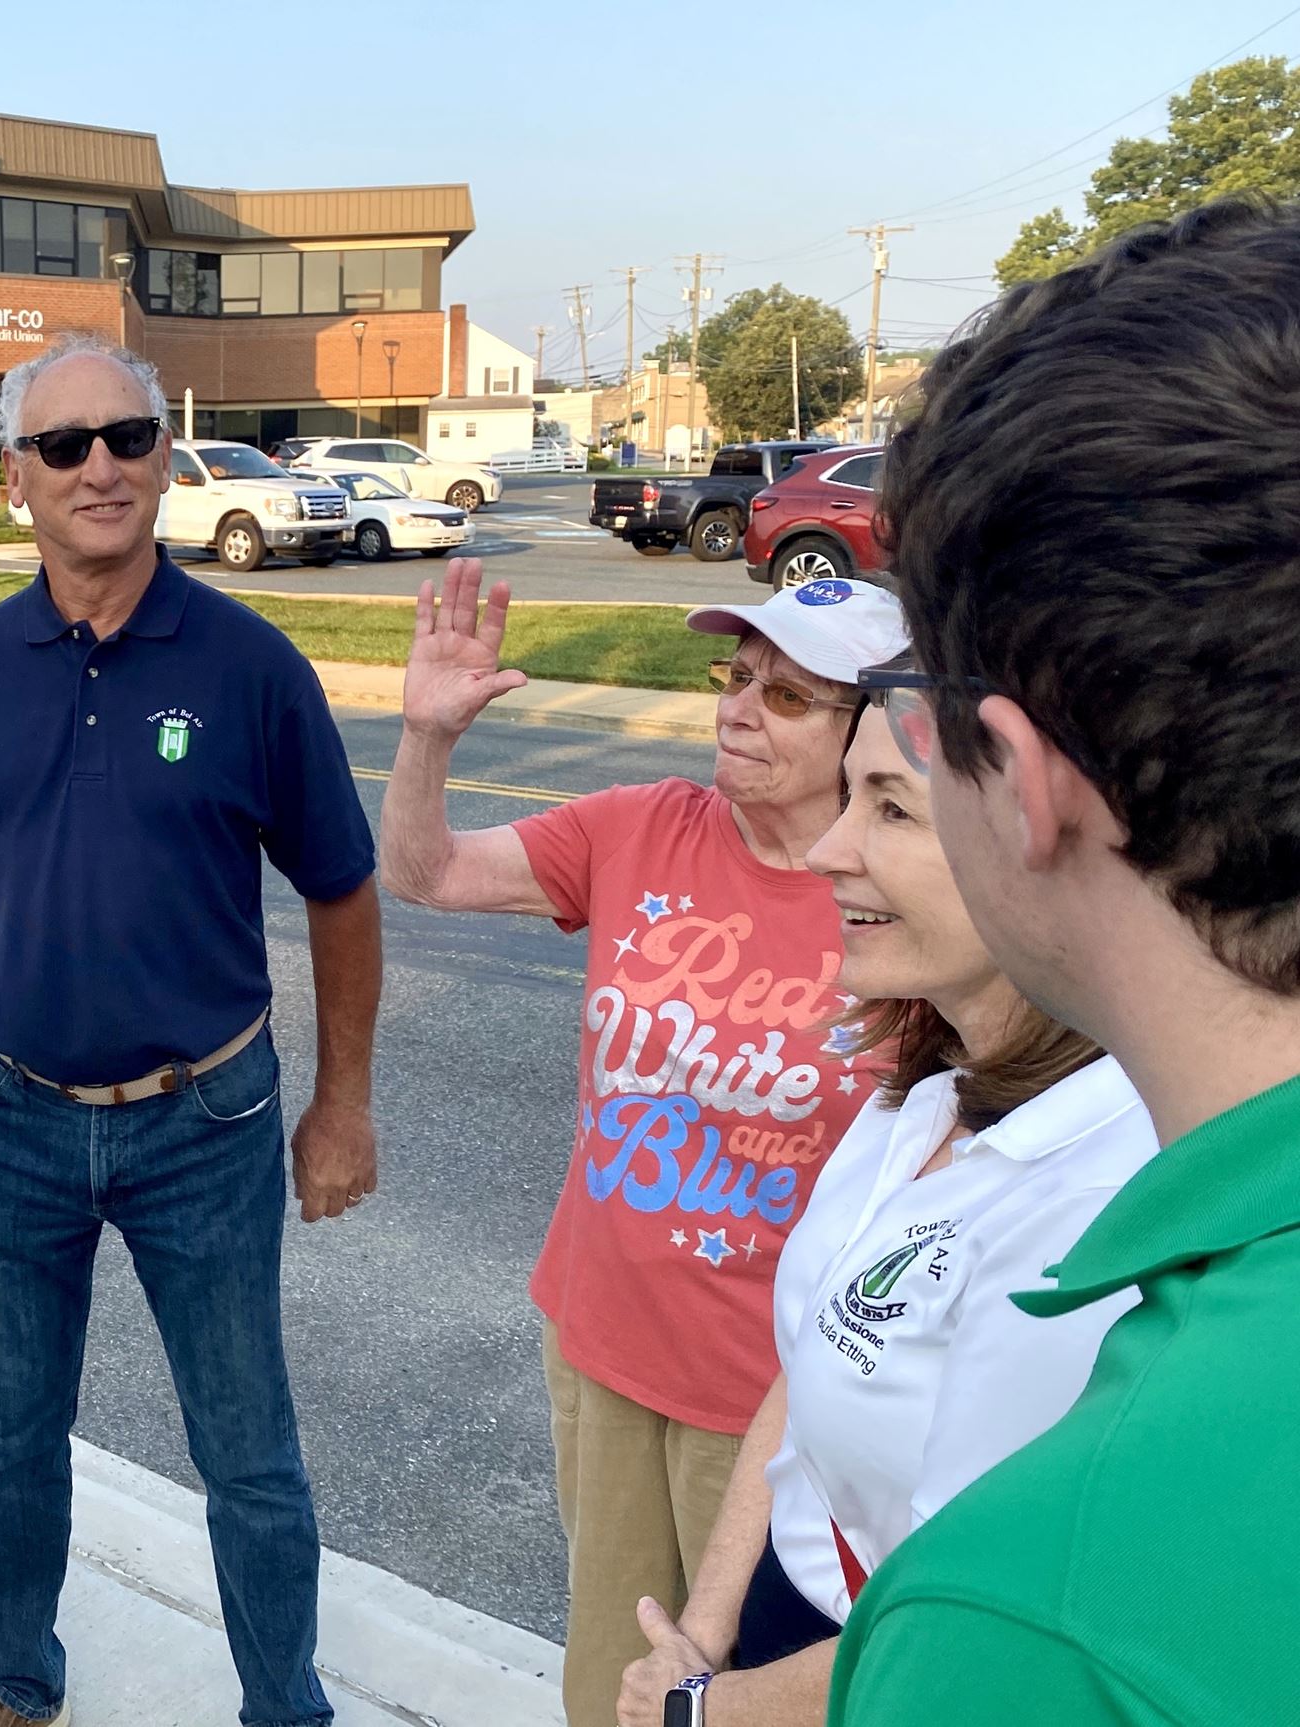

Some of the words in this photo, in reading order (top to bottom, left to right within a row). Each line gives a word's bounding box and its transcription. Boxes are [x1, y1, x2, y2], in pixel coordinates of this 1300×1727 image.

[14, 330, 44, 343] Union
[804, 585, 842, 602] NASA
[146, 710, 166, 723] Town
[180, 709, 193, 719] Bel
[192, 717, 203, 729] Air
[611, 912, 842, 1029] Red
[587, 985, 824, 1122] White
[586, 1094, 798, 1225] Blue
[728, 1121, 826, 1165] and
[928, 1247, 949, 1282] Air
